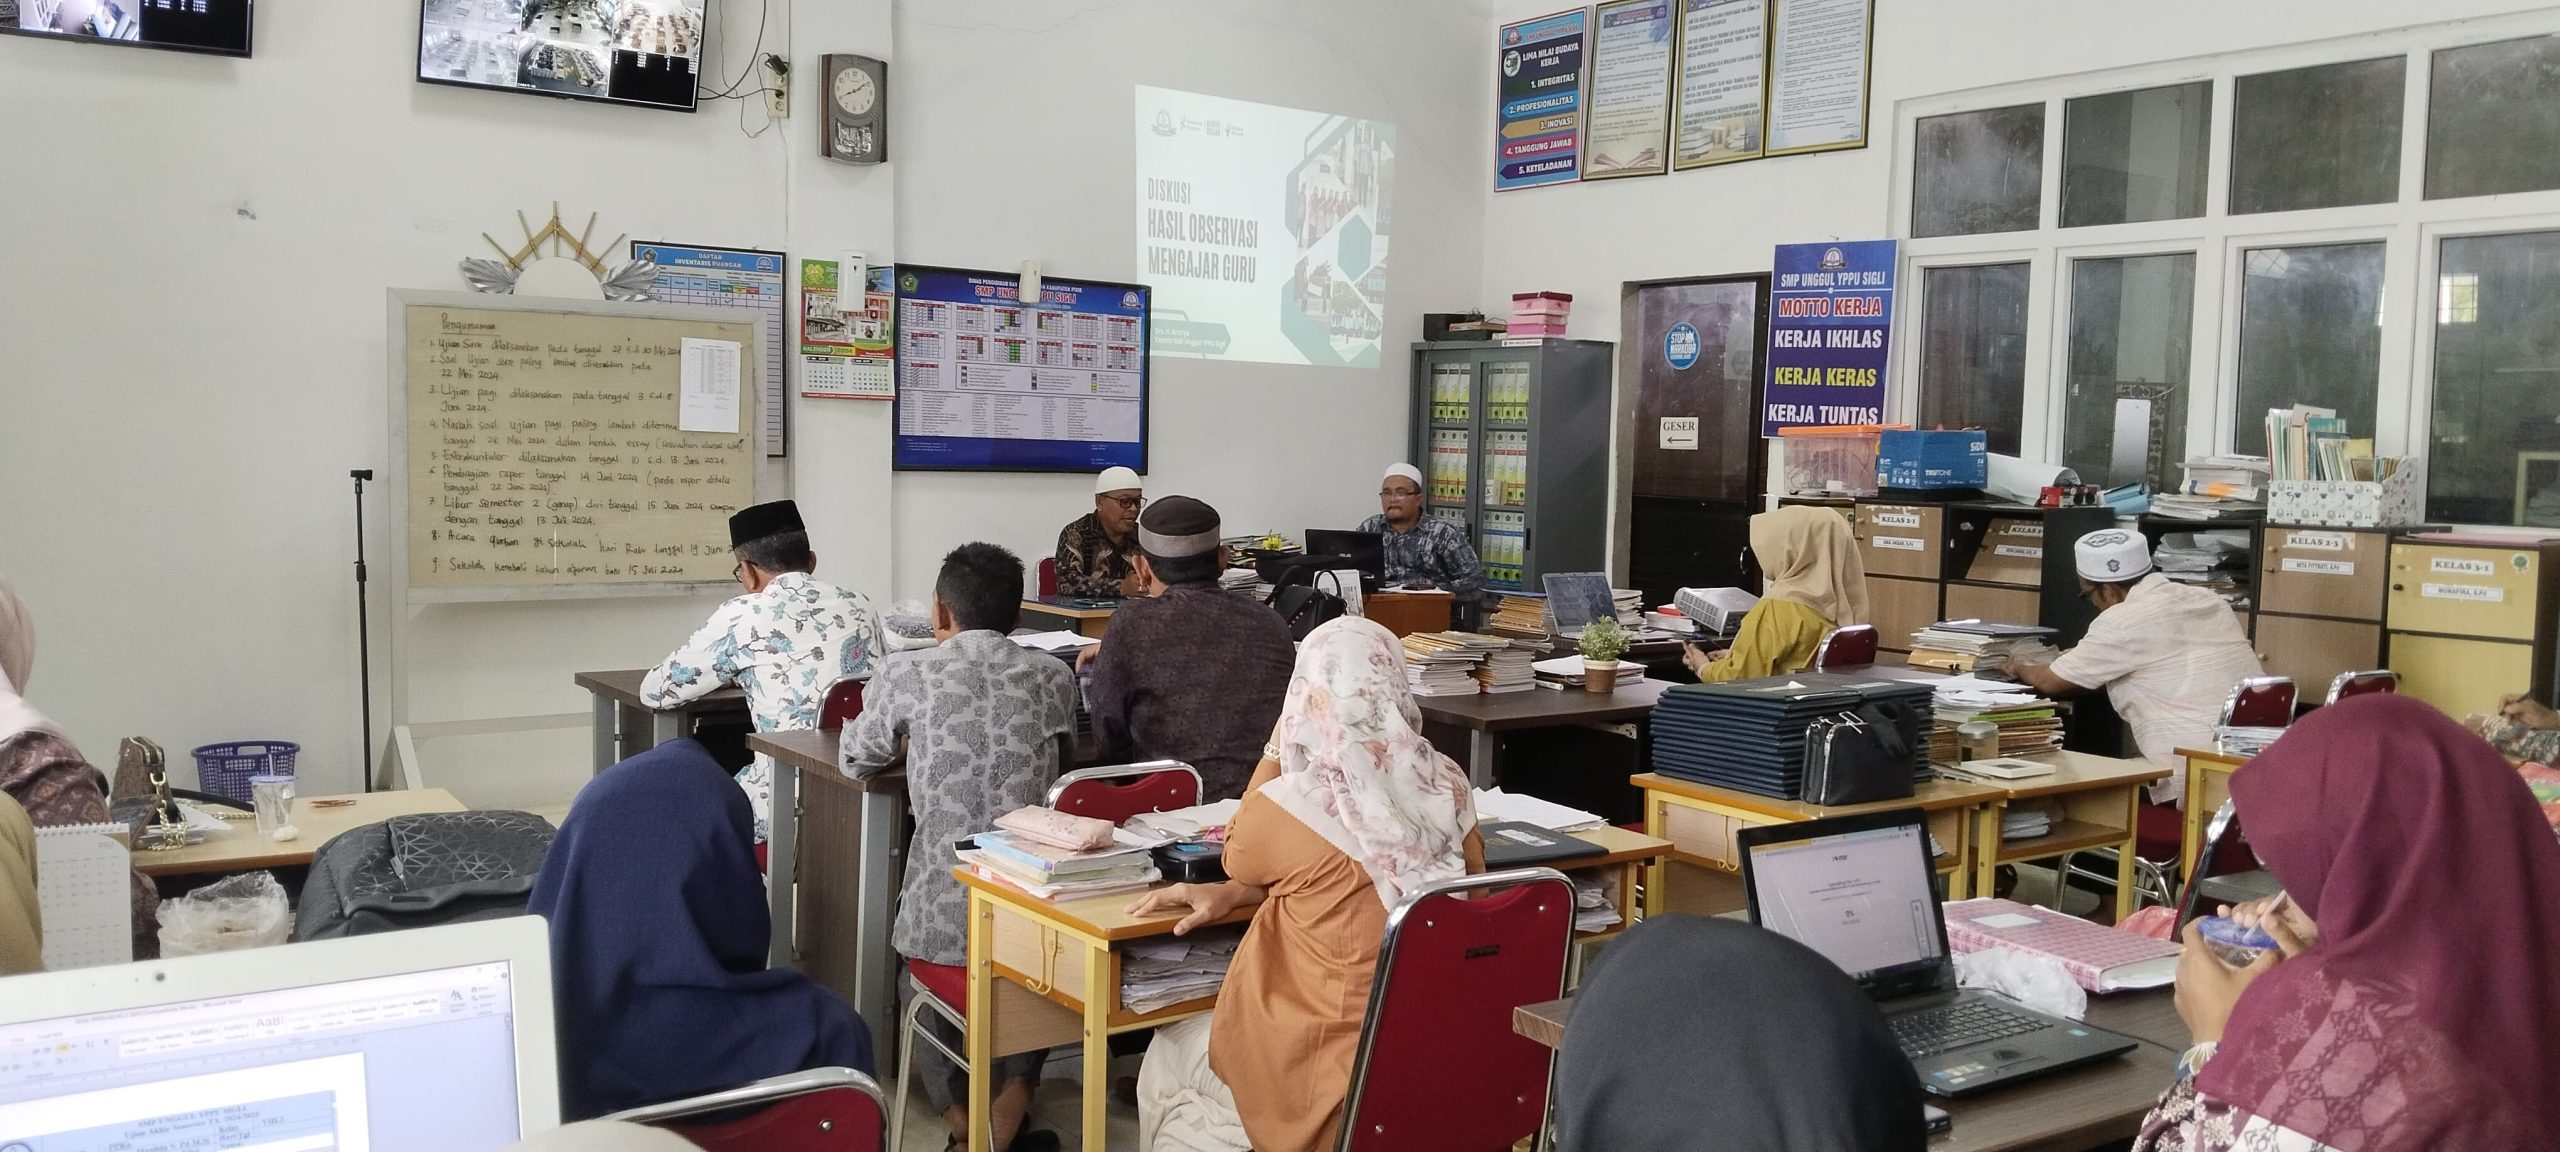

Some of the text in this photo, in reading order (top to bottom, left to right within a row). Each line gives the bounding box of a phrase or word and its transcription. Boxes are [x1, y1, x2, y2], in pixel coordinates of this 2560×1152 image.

[1522, 43, 1579, 62] LIMA NILAI BUDAYA
[1540, 57, 1559, 67] KERJA
[1538, 73, 1575, 88] INTEGRITAS
[1516, 96, 1574, 112] PROFESIONALITAS
[1547, 118, 1573, 128] INOVASI
[1515, 142, 1548, 154] TANGGUNG
[1550, 139, 1572, 149] JAWAB
[1526, 159, 1572, 173] KETELADANAN
[1148, 178, 1191, 205] DISKUSI
[1148, 208, 1258, 249] HASIL OBSERVASI
[675, 259, 711, 267] INVENTARIS
[1148, 246, 1256, 283] MENGAJAR GURU
[1781, 271, 1885, 287] SMP UNGGUL YPPU SIGLI
[975, 285, 995, 297] SMP
[1055, 293, 1076, 304] SIGLI
[1779, 297, 1882, 317] MOTTO KERJA
[441, 312, 496, 334] Pengumuman
[1775, 330, 1882, 348] KERJA IKHLAS
[1775, 367, 1876, 387] KERJA KERAS
[440, 384, 469, 400] Ujian
[478, 390, 497, 401] pagi
[509, 387, 561, 399] dilaksanakan
[572, 390, 594, 406] pada
[597, 391, 630, 404] tanggal
[1768, 404, 1878, 426] KERJA TUNTAS
[510, 419, 537, 433] ujian
[545, 420, 561, 432] pagi
[572, 420, 597, 433] paling
[608, 419, 636, 429] lambat
[1663, 422, 1694, 431] GESER
[443, 435, 475, 448] tanggal
[507, 435, 522, 446] Mei
[518, 451, 576, 464] dilaksanakan
[589, 455, 619, 466] tanggal
[443, 464, 489, 481] Pembagian
[499, 470, 525, 482] rapor
[536, 468, 567, 482] tanggal
[617, 472, 638, 483] 2024
[444, 482, 478, 495] tanggal
[444, 495, 473, 509] Libur
[532, 499, 540, 508] 2
[608, 497, 638, 512] tanggal
[663, 500, 680, 511] Juni
[686, 502, 703, 511] 2024
[444, 511, 478, 528] dengan
[488, 514, 524, 529] tanggal
[536, 516, 546, 525] 13
[1881, 516, 1905, 524] KELAS
[2012, 526, 2036, 534] KELAS
[448, 530, 475, 542] Acara
[599, 539, 616, 552] hari
[626, 543, 646, 555] Rabu
[655, 544, 683, 556] tanggal
[704, 545, 723, 555] Juni
[2290, 537, 2323, 546] KELAS
[450, 557, 486, 572] Sekolah
[628, 565, 638, 576] 15
[660, 565, 683, 575] 2024
[2434, 560, 2489, 573] KELAS 3-1
